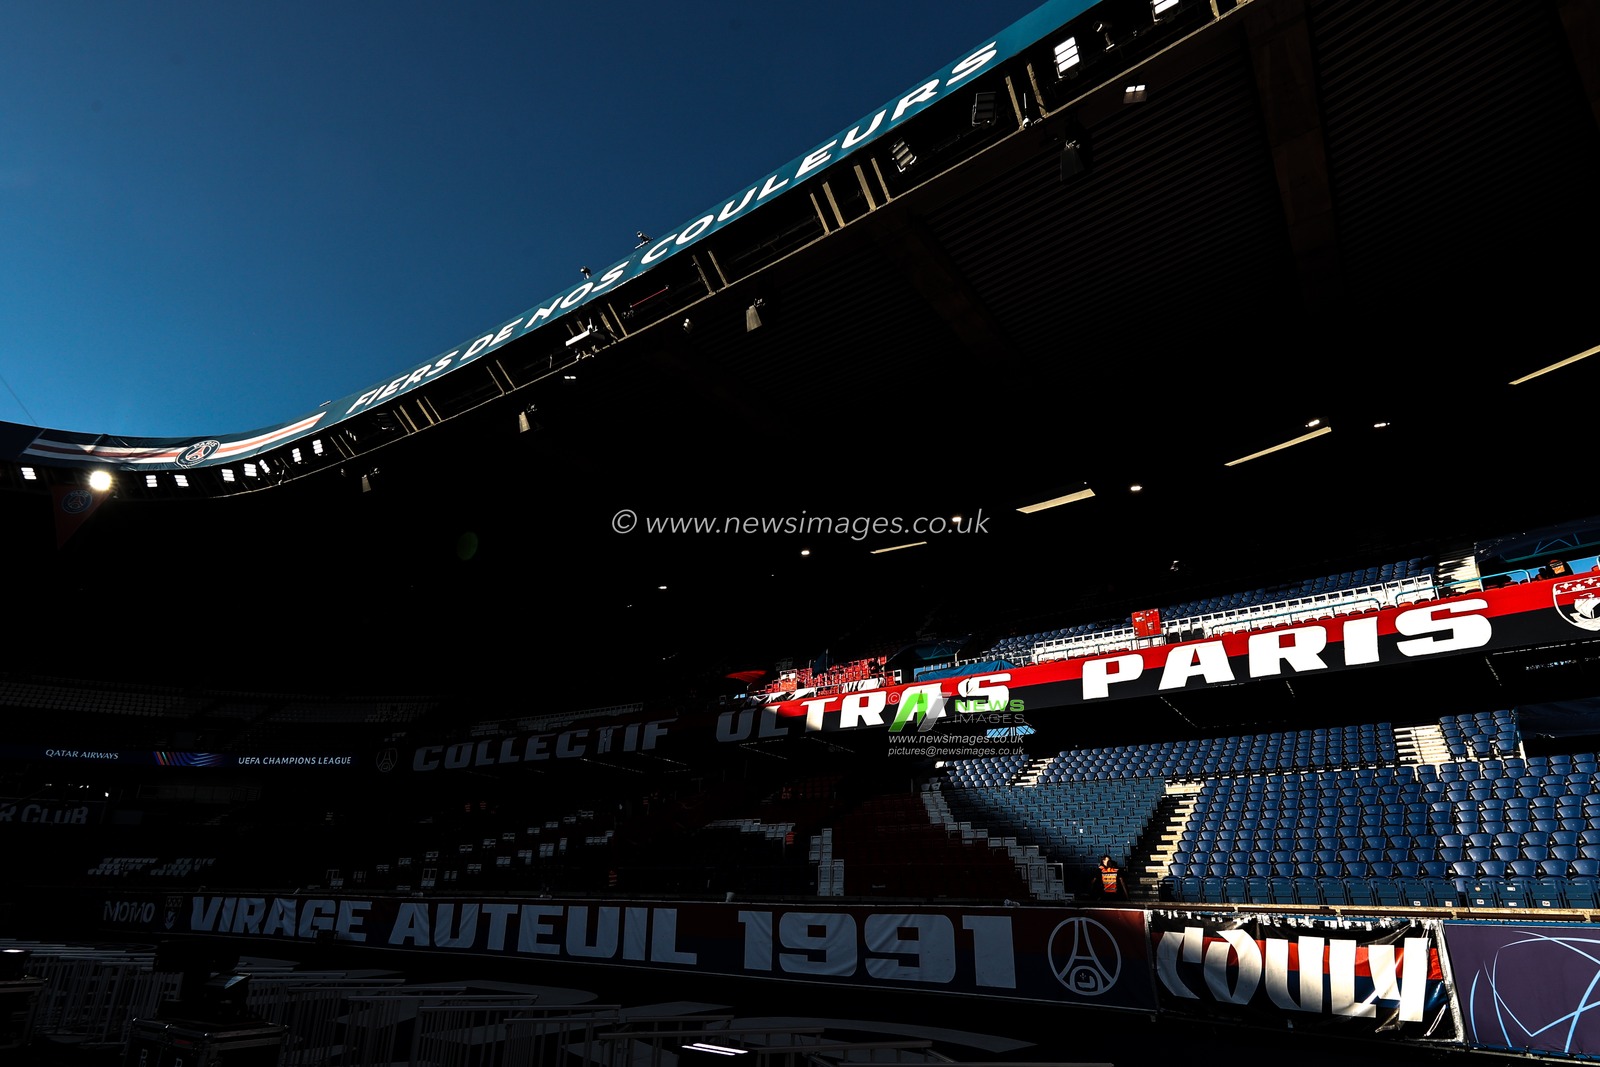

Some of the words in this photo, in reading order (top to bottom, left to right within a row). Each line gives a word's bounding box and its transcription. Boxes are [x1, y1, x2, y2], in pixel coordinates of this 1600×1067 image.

[345, 350, 460, 416] FIERS
[459, 317, 525, 362] DE
[524, 260, 631, 330] NOS
[640, 41, 997, 265] COULEURS
[412, 717, 682, 773] COLLECTIF
[715, 673, 1013, 743] ULTRAS
[1081, 598, 1493, 701] PARIS
[45, 749, 79, 759] QATAR
[80, 751, 119, 760] AIRWAYS
[238, 756, 261, 765] UEFA
[262, 756, 316, 765] CHAMPIONS
[318, 756, 352, 765] LEAGUE
[190, 895, 373, 944] VIRAGE
[387, 903, 698, 967] AUTEUIL
[737, 909, 1018, 991] 1991
